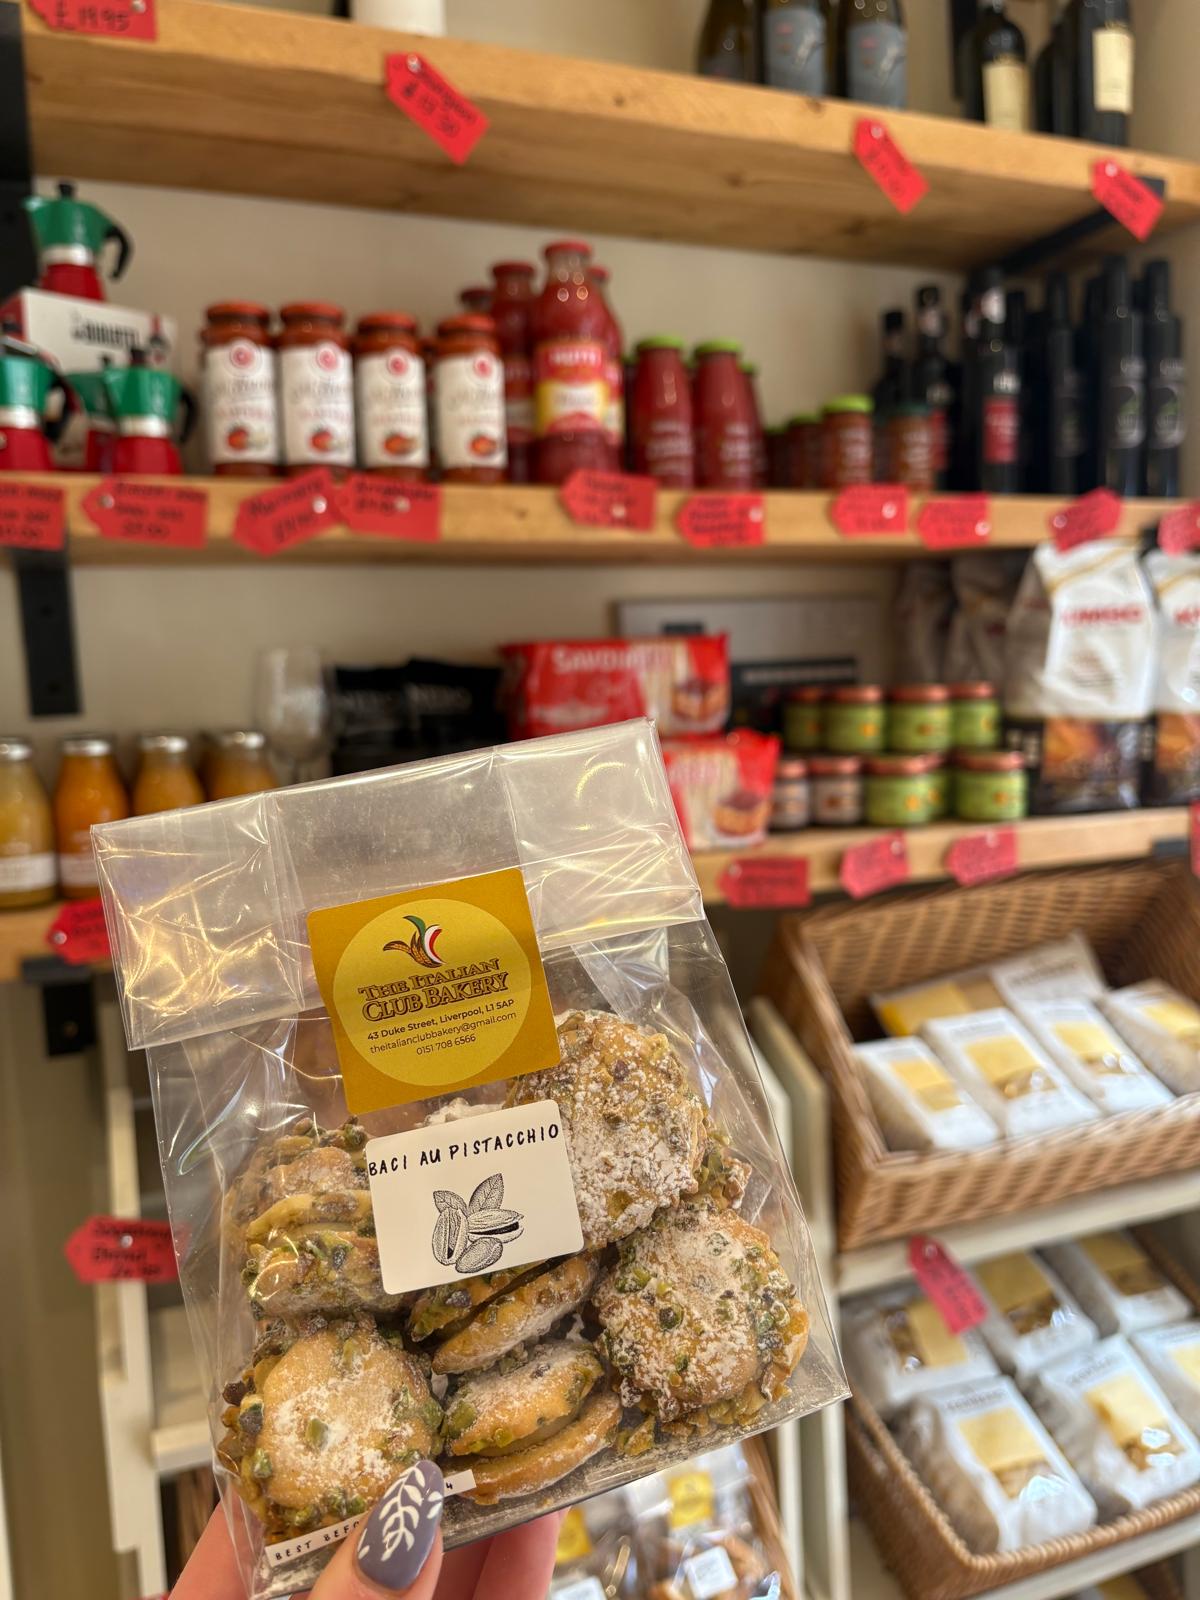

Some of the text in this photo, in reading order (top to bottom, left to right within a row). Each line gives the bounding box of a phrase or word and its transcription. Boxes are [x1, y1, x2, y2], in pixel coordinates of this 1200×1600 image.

[358, 958, 500, 1001] THE ITALIAN
[362, 971, 509, 1022] CLUB BAKERY
[367, 999, 514, 1041] 43 Duke Street, Liverpool, L1 5AP
[370, 1011, 517, 1054] theitalianclubbakery@gmail.com
[416, 1034, 476, 1055] 0151 708 6566
[368, 1124, 559, 1176] BACI AU PISTACCHIO
[275, 1540, 312, 1561] BEST
